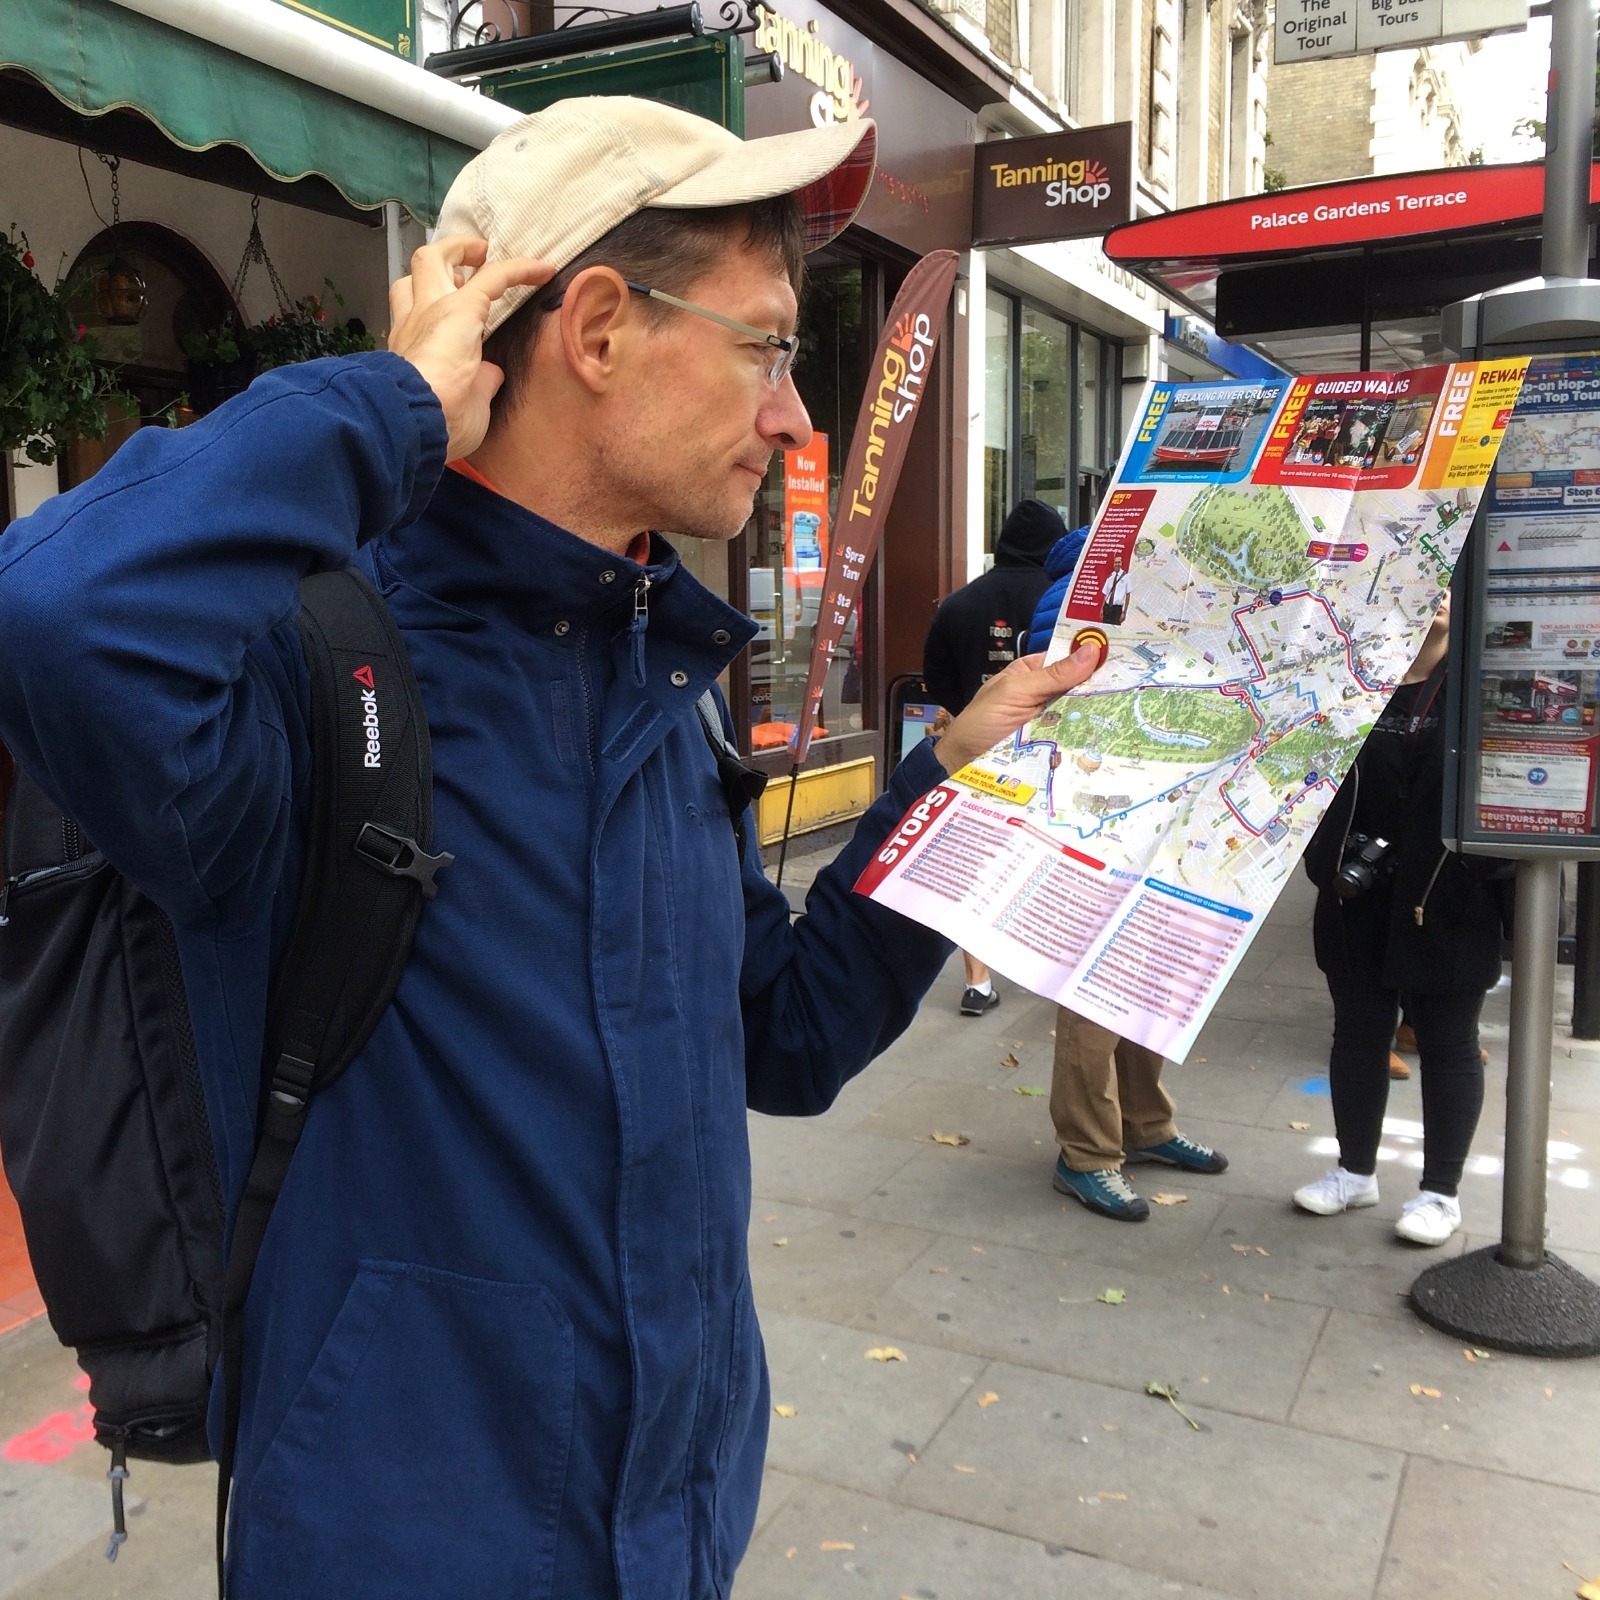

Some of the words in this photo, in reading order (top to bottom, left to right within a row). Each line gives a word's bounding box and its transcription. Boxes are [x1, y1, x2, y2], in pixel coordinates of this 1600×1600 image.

[1303, 0, 1331, 13] The
[1283, 11, 1347, 34] Original
[1378, 11, 1419, 27] Tours
[1297, 35, 1333, 50] Tour
[755, 4, 851, 119] Tanning
[990, 157, 1085, 189] Tanning
[1045, 179, 1112, 208] Shop
[1251, 211, 1309, 230] Palace
[1313, 199, 1391, 221] Gardens
[1395, 190, 1468, 211] Terrace
[893, 313, 934, 424] Shop
[1174, 391, 1218, 404] RELAXING
[1218, 389, 1244, 402] RIVER
[1244, 388, 1280, 400] CRUISE
[1315, 380, 1361, 395] GUIDED
[1364, 378, 1411, 395] WALKS
[1521, 380, 1555, 395] p-on
[1346, 404, 1359, 412] Harry
[1438, 371, 1475, 437] FREE
[1517, 393, 1542, 406] pen
[1543, 392, 1569, 404] Top
[1138, 389, 1171, 442] FREE
[1273, 383, 1312, 439] FREE
[849, 348, 906, 522] Tanning
[796, 455, 817, 473] Now
[788, 474, 825, 494] Installed
[1567, 488, 1594, 497] Stop
[844, 546, 865, 564] Spra
[360, 688, 381, 768] Reebok
[1530, 771, 1546, 782] 37
[995, 785, 1018, 798] LONDON
[878, 789, 948, 866] STOPS
